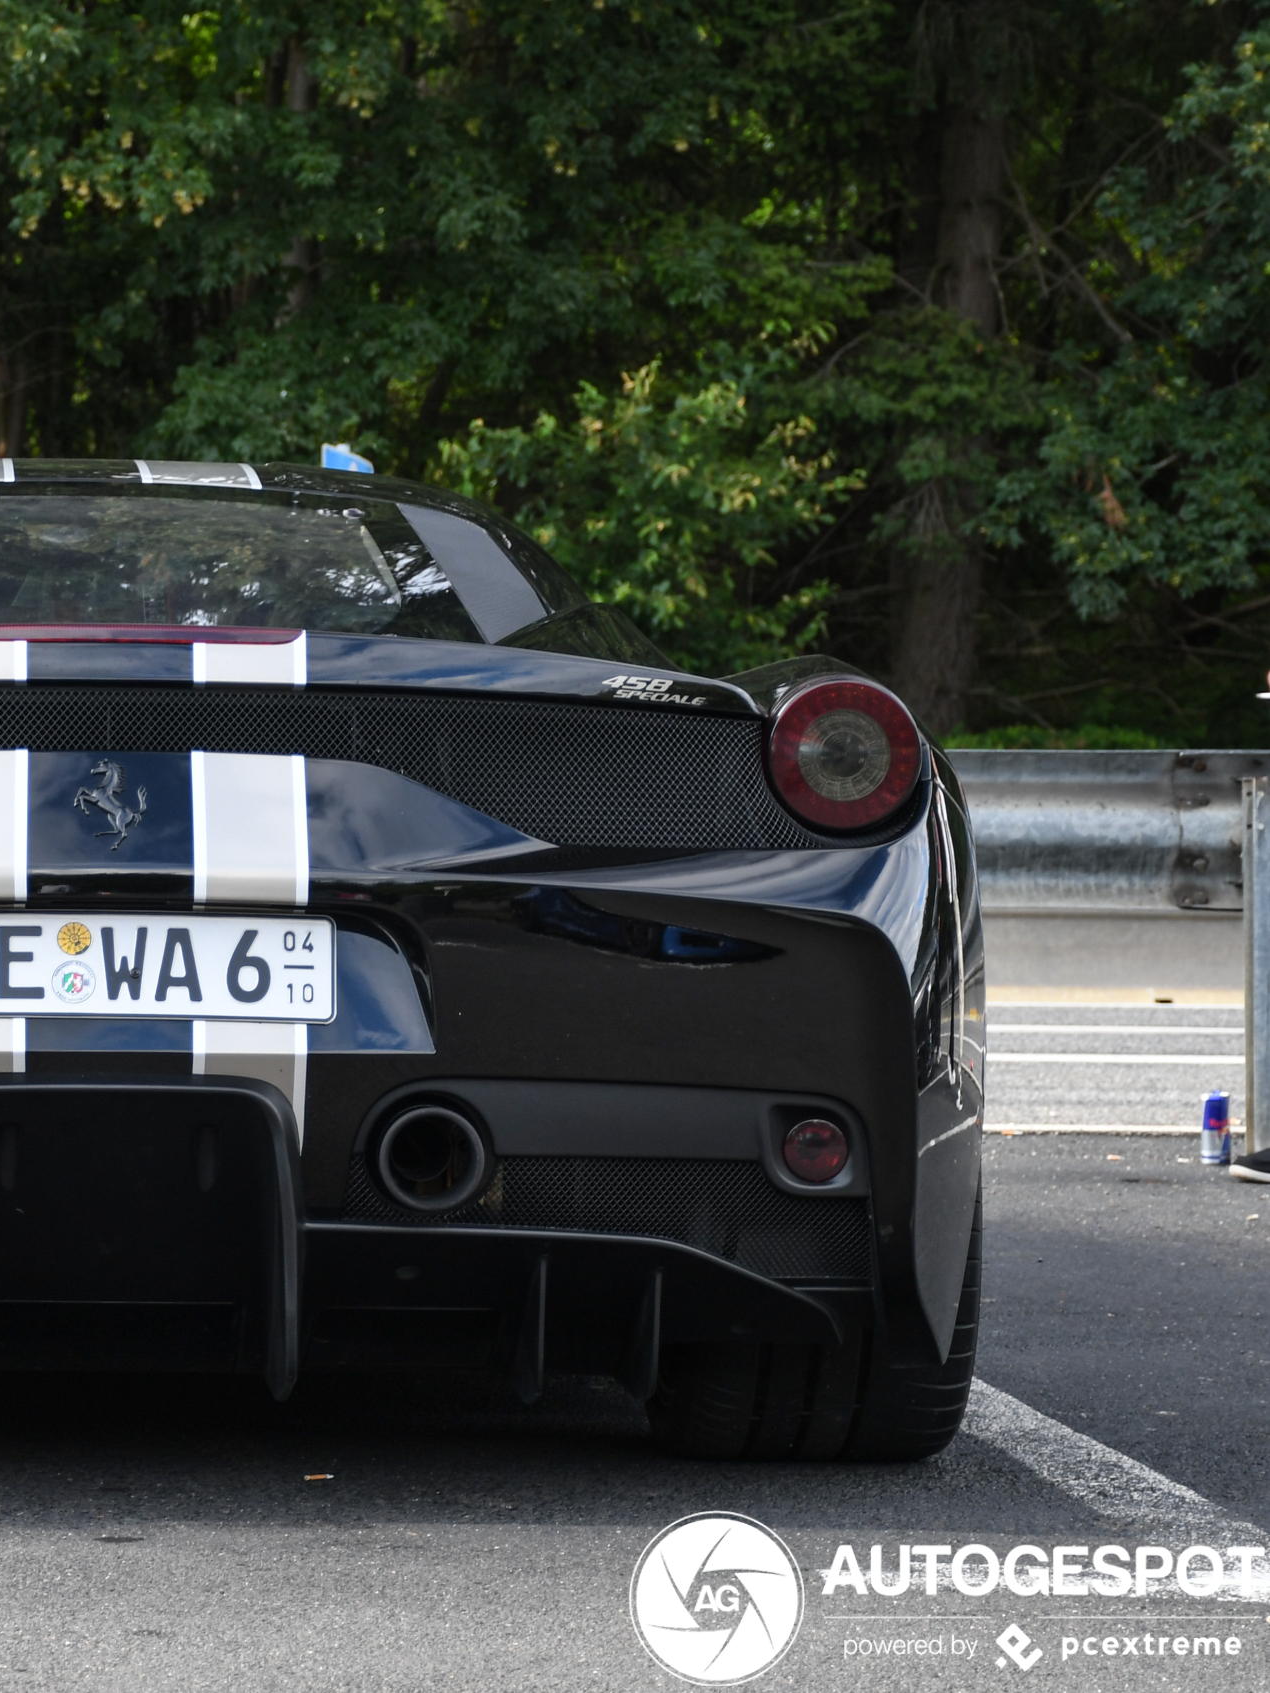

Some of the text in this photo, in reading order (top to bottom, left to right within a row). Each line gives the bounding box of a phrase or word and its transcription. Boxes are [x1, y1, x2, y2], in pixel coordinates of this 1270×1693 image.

[602, 675, 674, 692] 458
[613, 689, 706, 706] SPECIALE
[283, 931, 315, 954] 04
[100, 926, 203, 1003] WA
[227, 929, 272, 1003] 6
[286, 983, 315, 1004] 10
